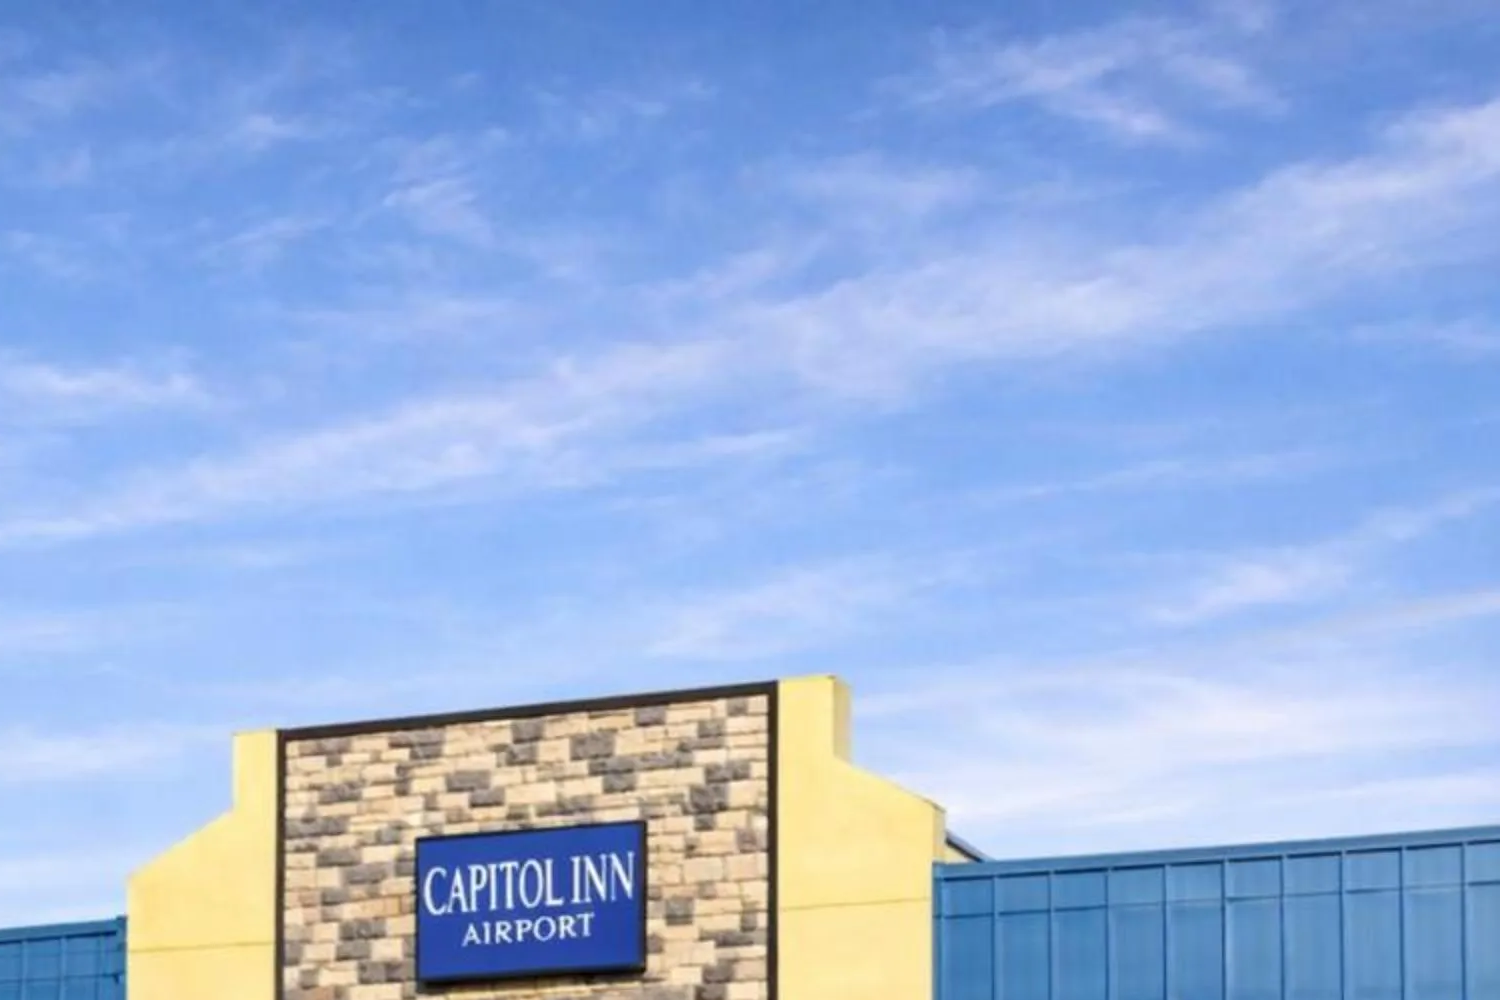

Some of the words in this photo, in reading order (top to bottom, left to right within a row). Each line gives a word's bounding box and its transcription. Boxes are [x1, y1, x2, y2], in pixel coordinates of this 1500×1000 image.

[422, 858, 563, 916] CAPITOL
[570, 850, 635, 904] INN
[461, 912, 595, 947] AIRPORT
